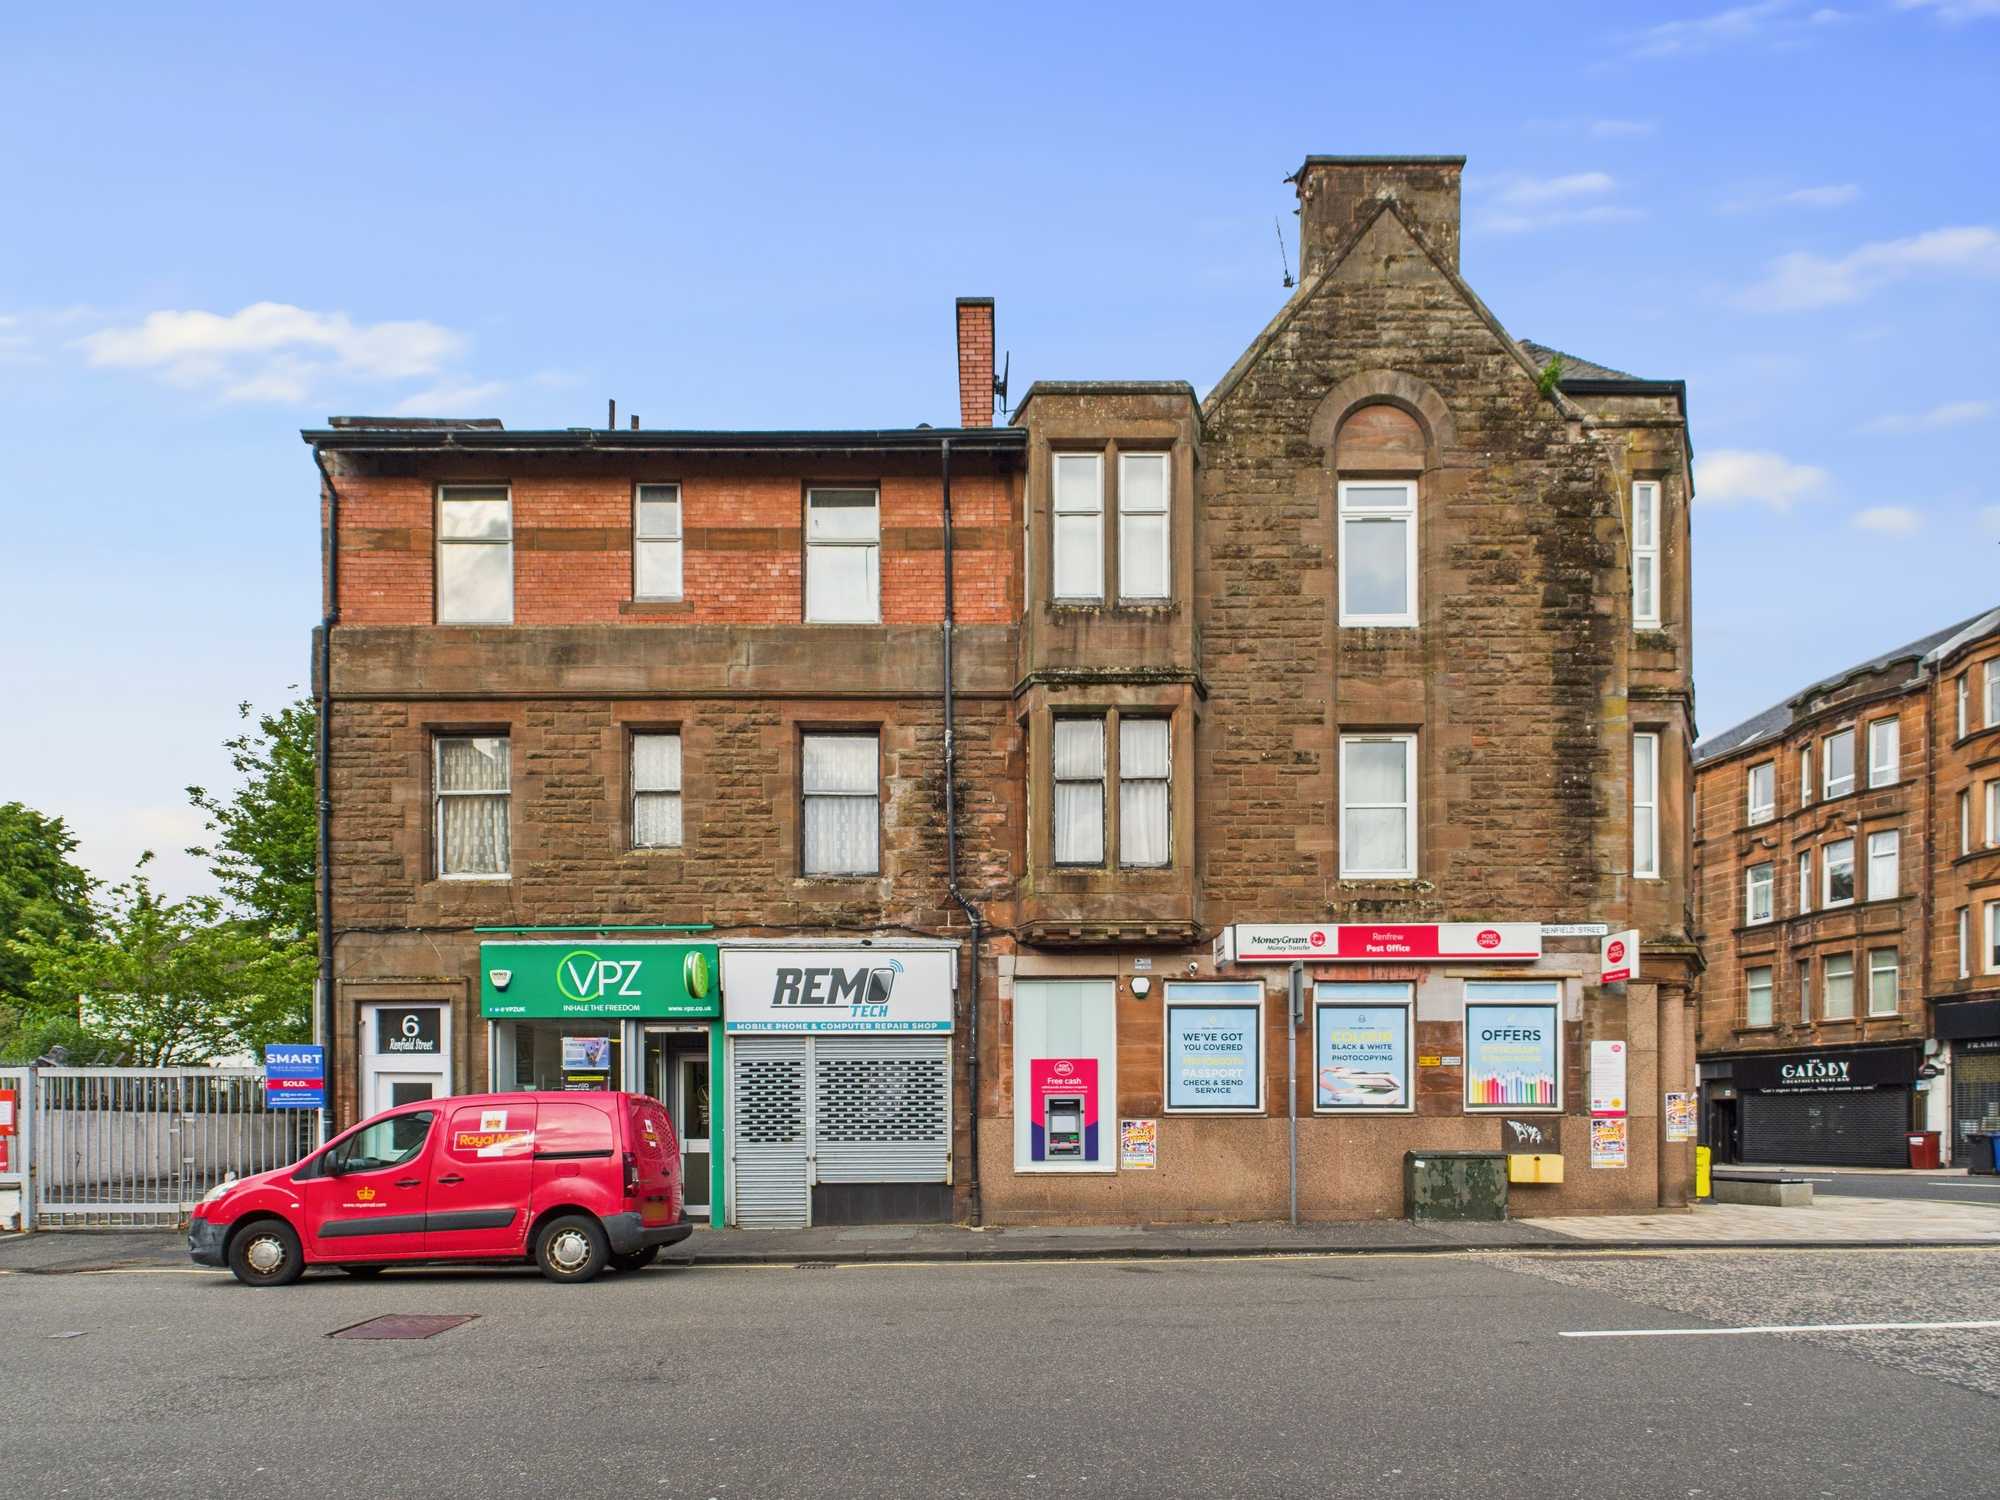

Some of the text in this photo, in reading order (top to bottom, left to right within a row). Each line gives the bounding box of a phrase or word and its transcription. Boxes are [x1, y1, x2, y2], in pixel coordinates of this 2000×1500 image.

[1577, 925, 1605, 934] STREET
[1251, 936, 1307, 945] MoneyGram
[1372, 932, 1403, 941] Renfrew
[1366, 944, 1410, 952] Post Office
[567, 960, 642, 996] VPZ
[563, 1004, 640, 1012] INHALE THE FREEDOM
[851, 1006, 888, 1017] TECH
[402, 1015, 420, 1037] 6
[875, 1022, 909, 1030] REPAIR
[912, 1022, 937, 1030] SHOP
[1183, 1033, 1243, 1041] WE'VE GOT
[1482, 1029, 1542, 1041] OFFERS
[390, 1038, 433, 1051] Renfield Street
[266, 1053, 322, 1064] SMART
[1183, 1069, 1243, 1078] PASSPORT
[1782, 1062, 1849, 1078] GATSBY
[460, 1134, 495, 1147] Royal
